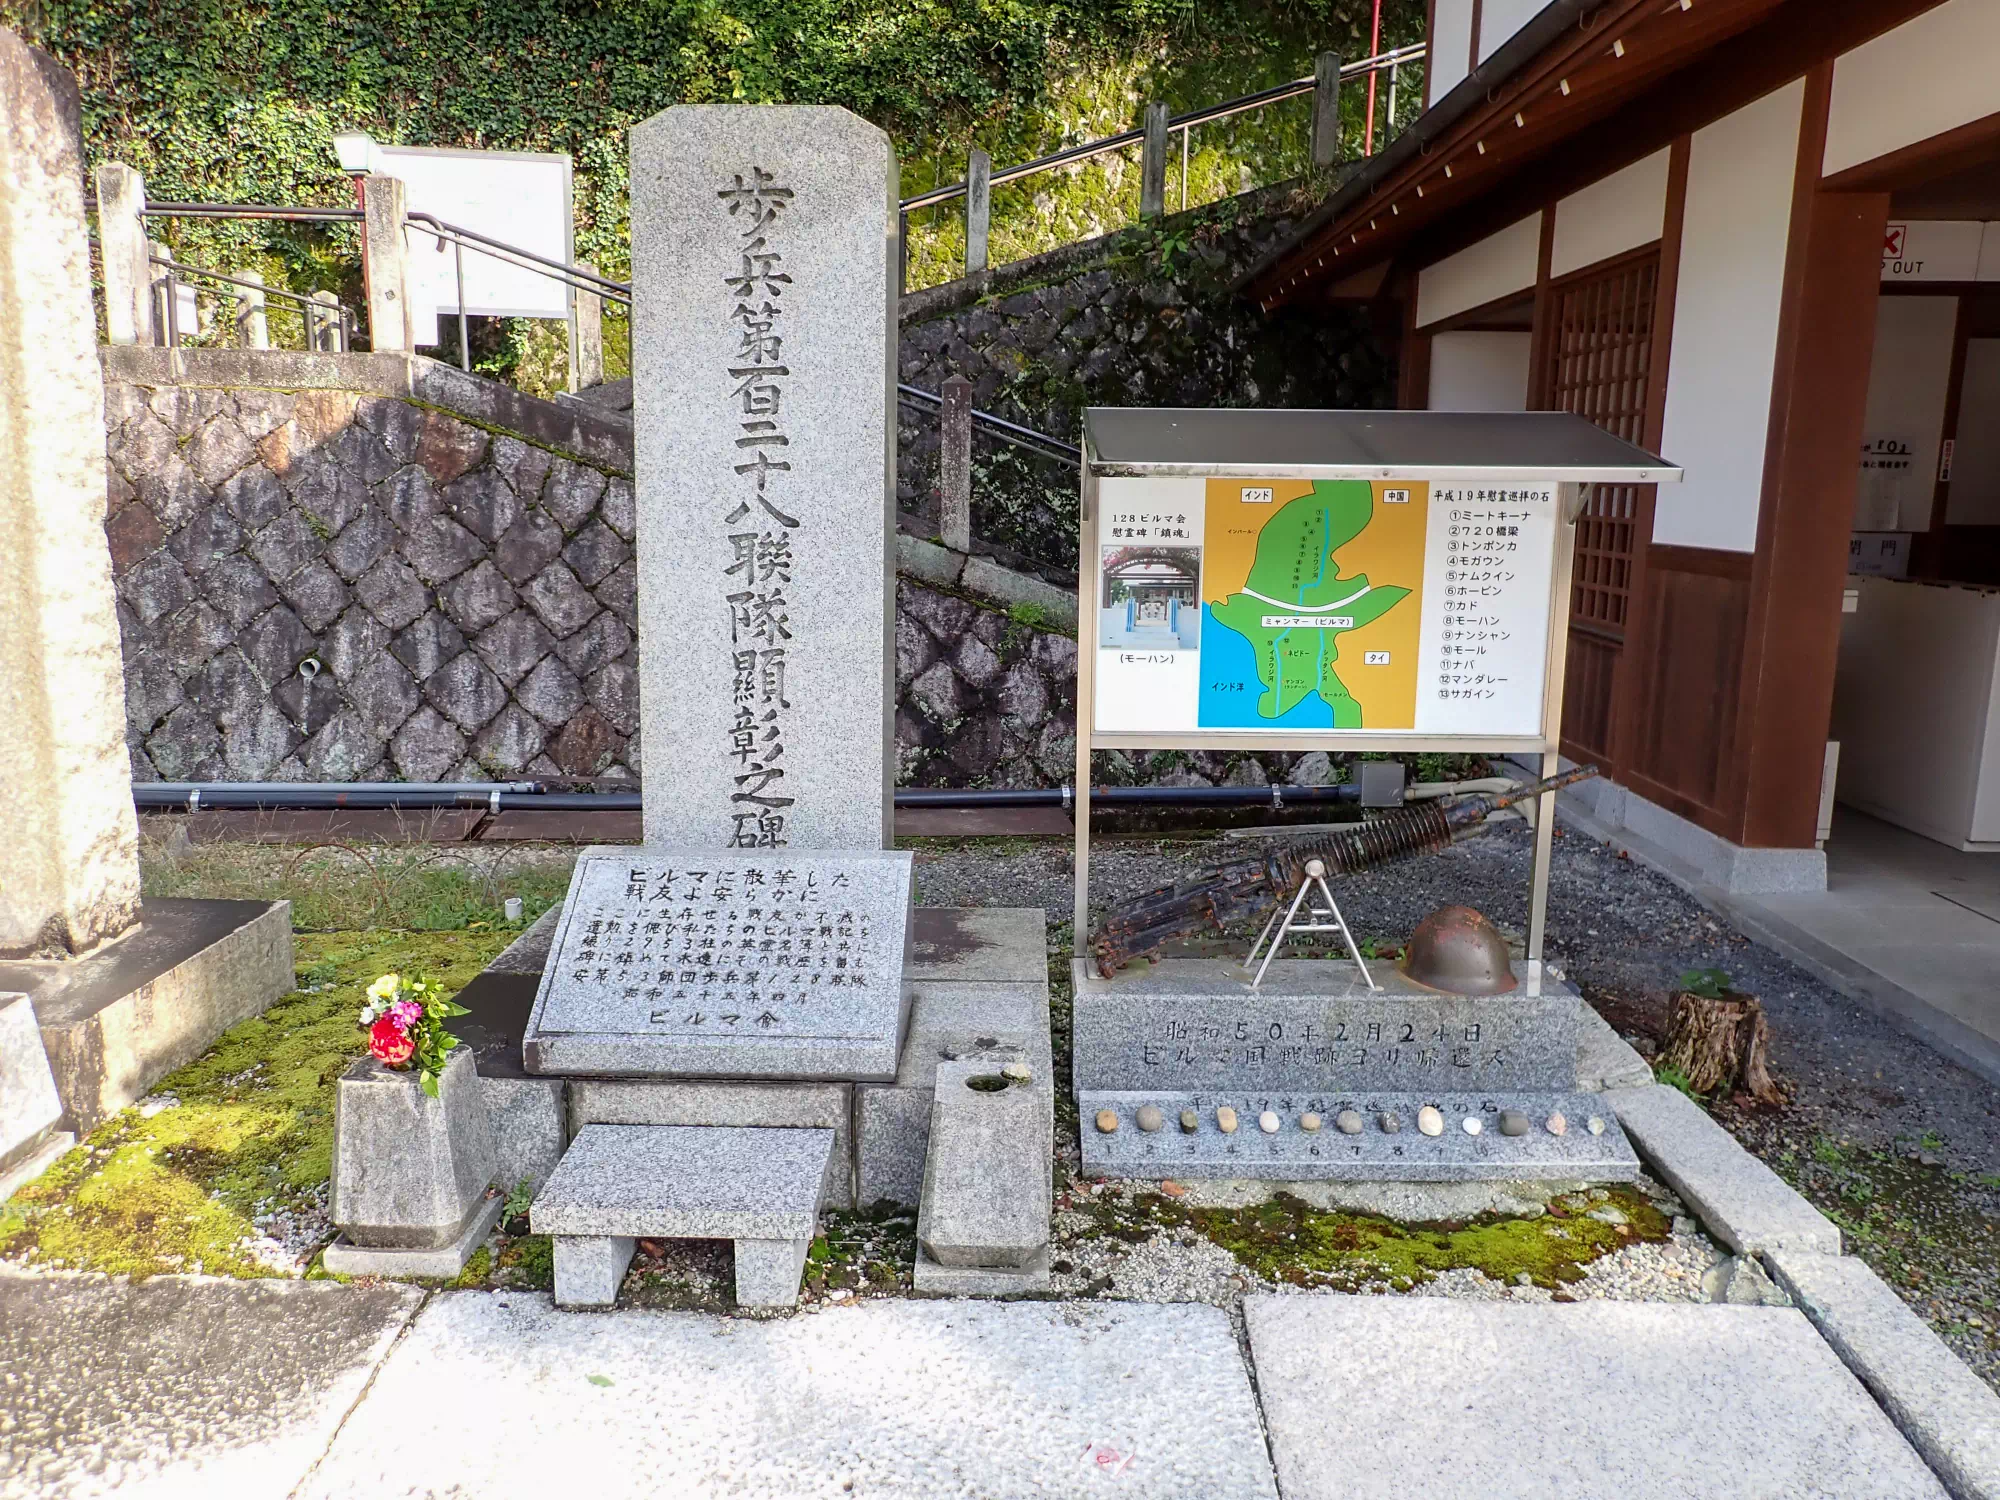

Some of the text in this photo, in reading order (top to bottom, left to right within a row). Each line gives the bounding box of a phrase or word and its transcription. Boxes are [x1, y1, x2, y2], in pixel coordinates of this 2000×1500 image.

[1892, 261, 1924, 274] OUT
[1244, 490, 1270, 501] インド
[1388, 491, 1405, 502] 中国
[1449, 509, 1532, 522] ①ミートキーナ
[1446, 555, 1505, 567] ④モガウン
[1445, 570, 1515, 582] ⑤ナムクイン
[1443, 600, 1479, 612] ⑦カド
[1442, 615, 1501, 627] ⑧モーハン
[1441, 630, 1512, 642] ⑨ナンシャン
[1440, 644, 1488, 656] ⑩モール
[1369, 653, 1386, 663] タイ
[1438, 674, 1509, 686] ⑫マンダレー
[1211, 682, 1245, 693] インド洋
[1437, 688, 1496, 700] ⑬サガイン
[1310, 1145, 1320, 1156] 6
[1394, 1145, 1403, 1156] 8
